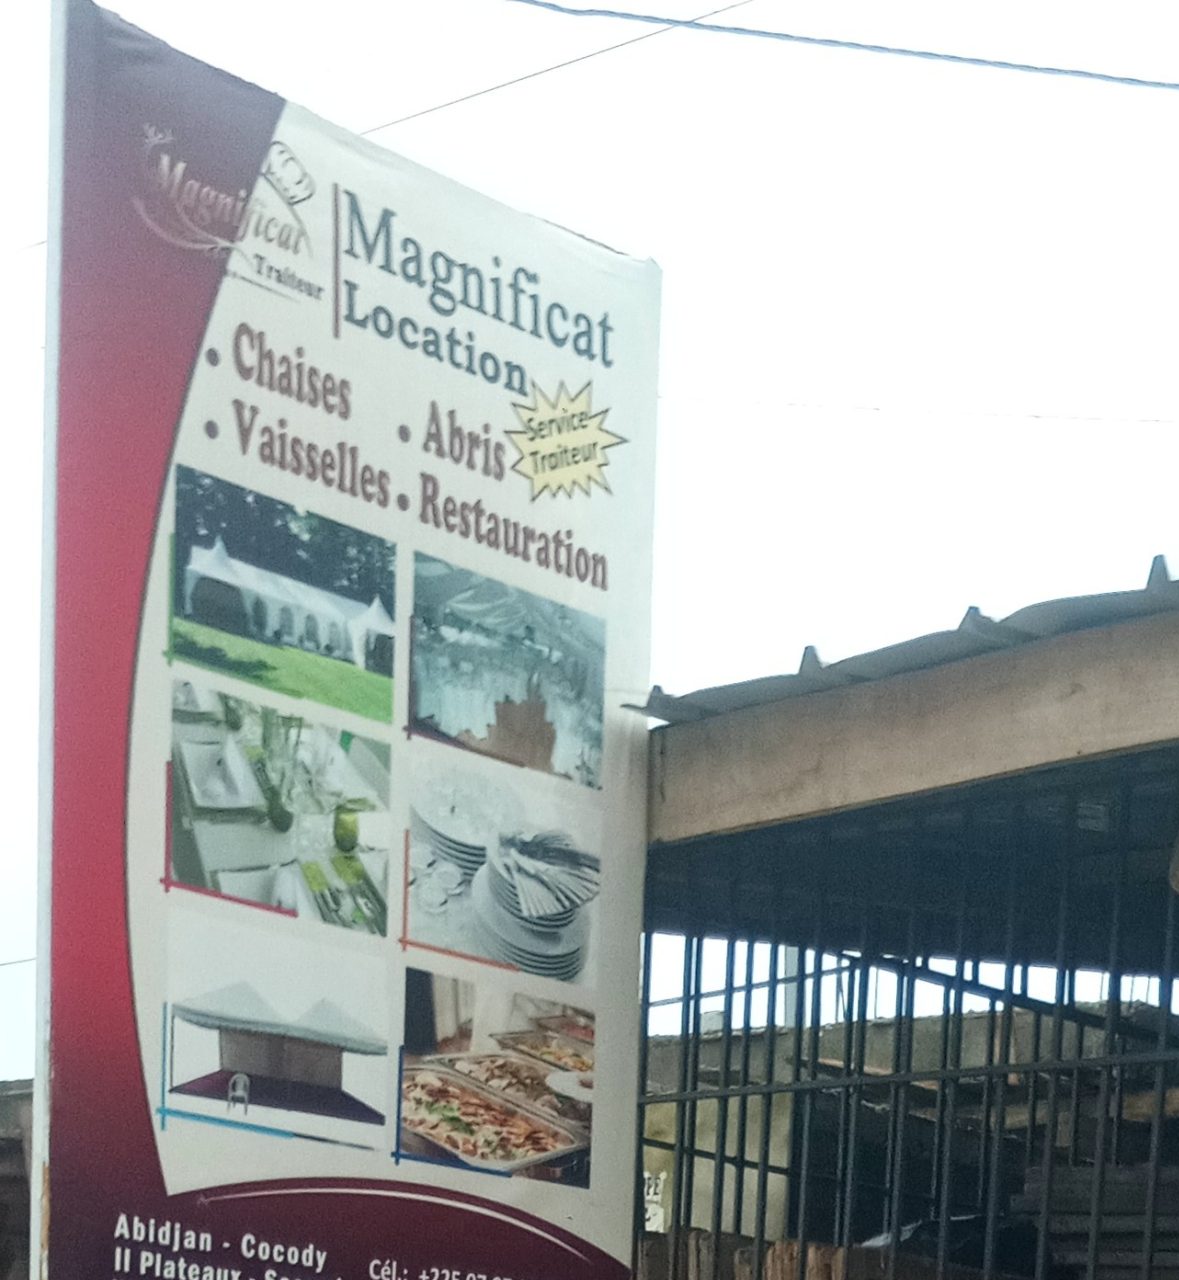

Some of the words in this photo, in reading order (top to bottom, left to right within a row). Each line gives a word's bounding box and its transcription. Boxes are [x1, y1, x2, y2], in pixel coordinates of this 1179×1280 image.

[343, 188, 615, 369] Magnificat
[232, 322, 352, 421] Chaises
[343, 279, 529, 397] Location
[232, 398, 391, 509] Vaisselles
[421, 400, 506, 483] Abris
[525, 409, 591, 443] Service
[418, 471, 609, 592] Restauration
[113, 1212, 213, 1253] Abidjan
[240, 1232, 328, 1274] Cocody
